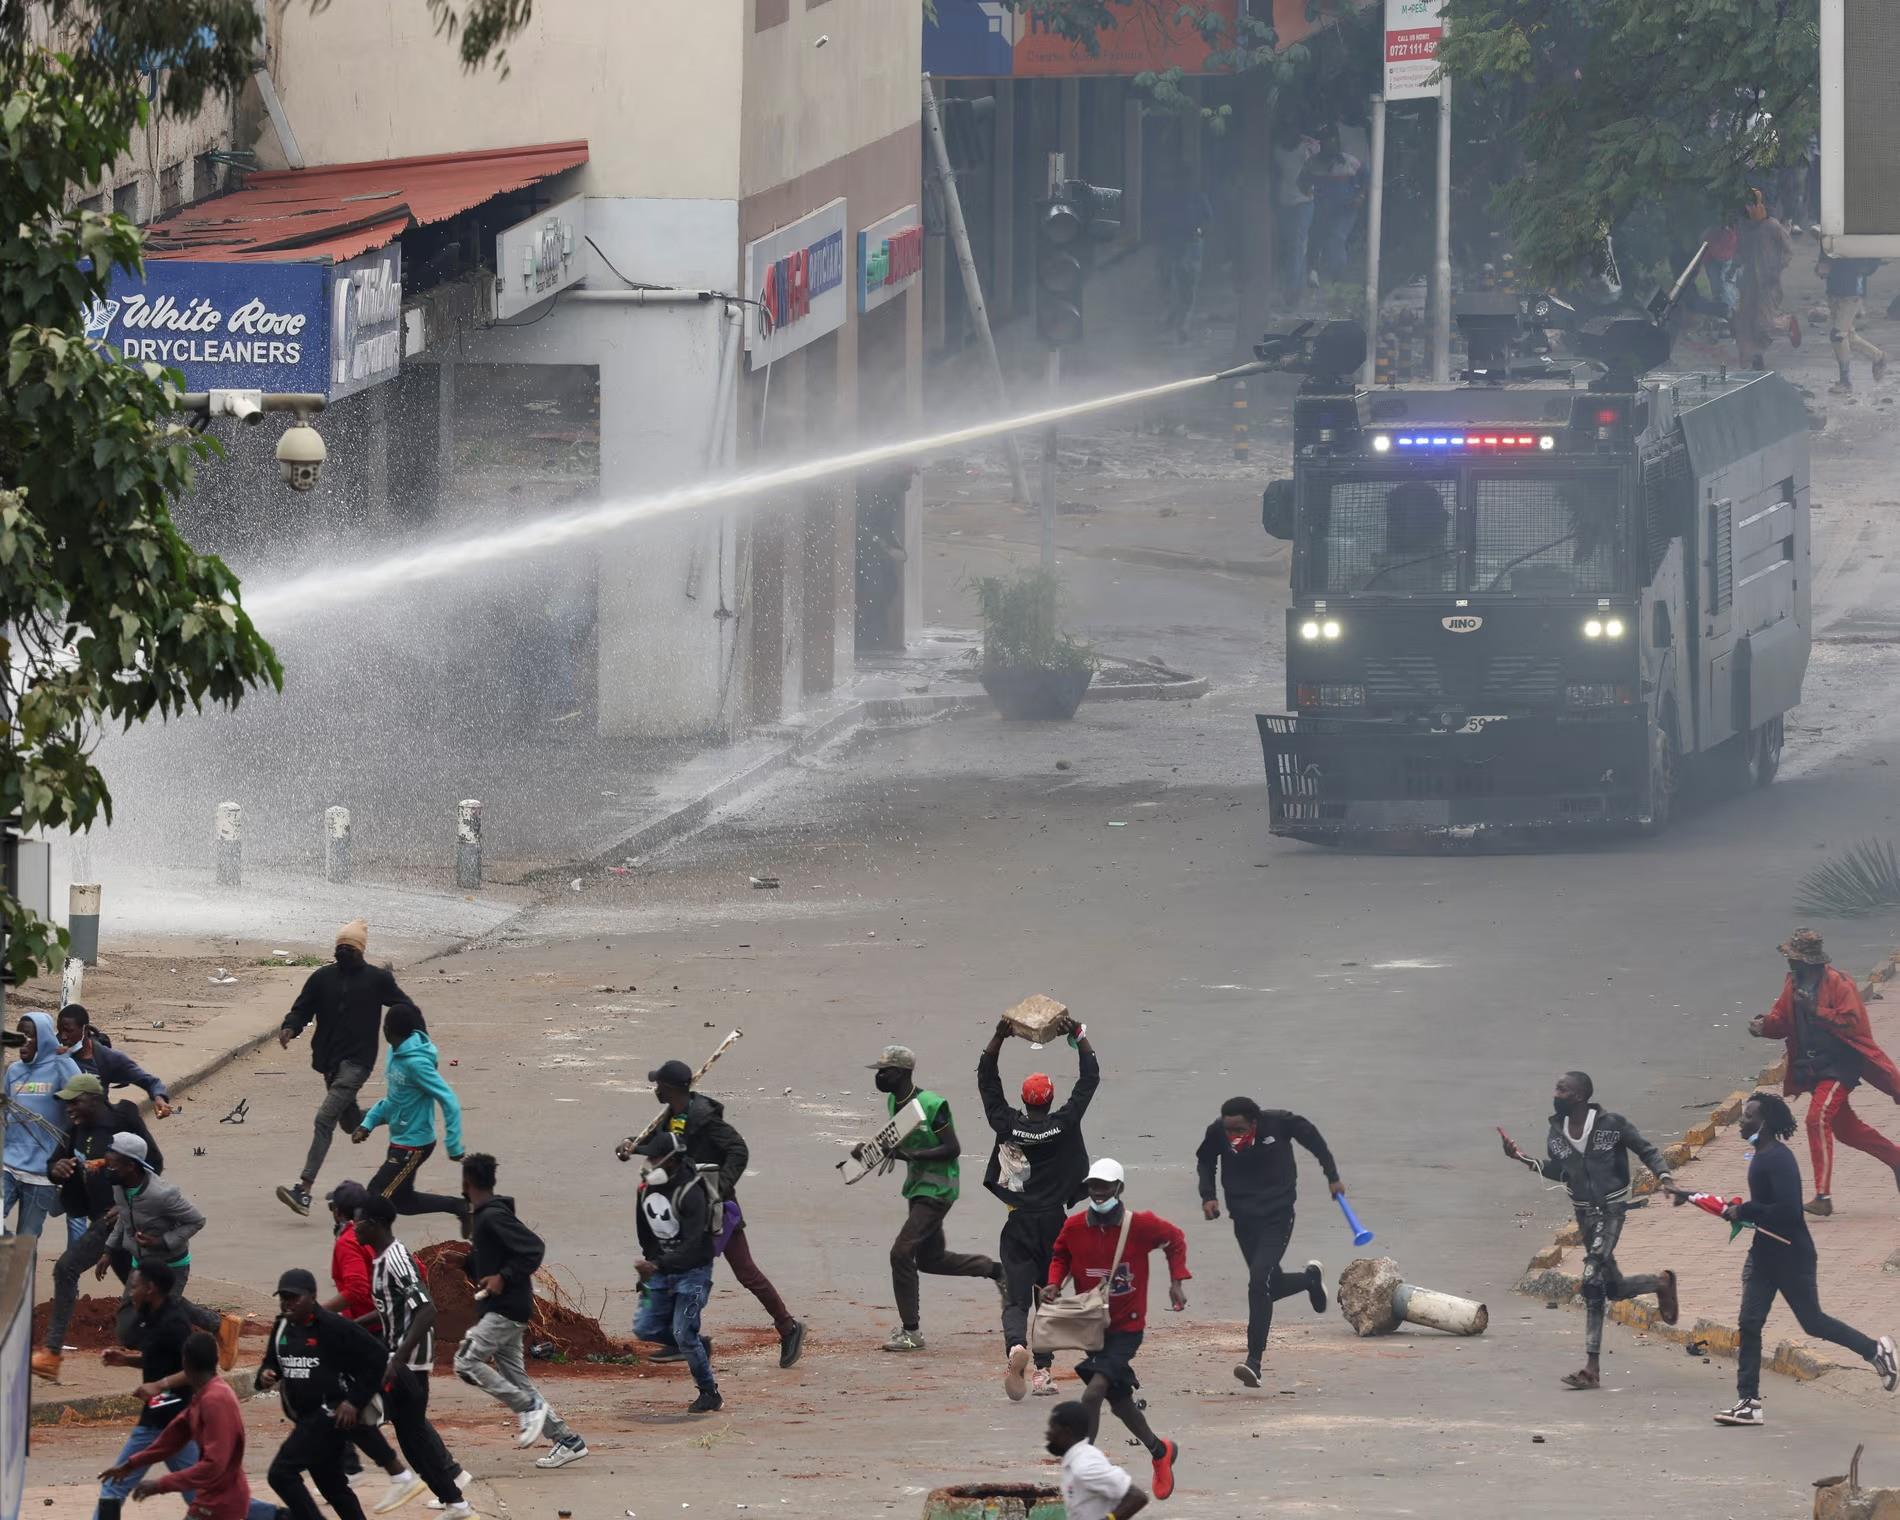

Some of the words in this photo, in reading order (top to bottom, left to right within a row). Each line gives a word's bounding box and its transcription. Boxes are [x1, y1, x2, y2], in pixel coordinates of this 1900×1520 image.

[1390, 44, 1408, 56] 0727
[1409, 43, 1422, 55] 111
[122, 294, 222, 332] White
[227, 297, 306, 335] Rose
[123, 338, 300, 364] DRYCLEANERS
[1449, 619, 1476, 629] JINO
[1012, 1127, 1061, 1139] INTERNATIONAL
[277, 1354, 320, 1368] mirates
